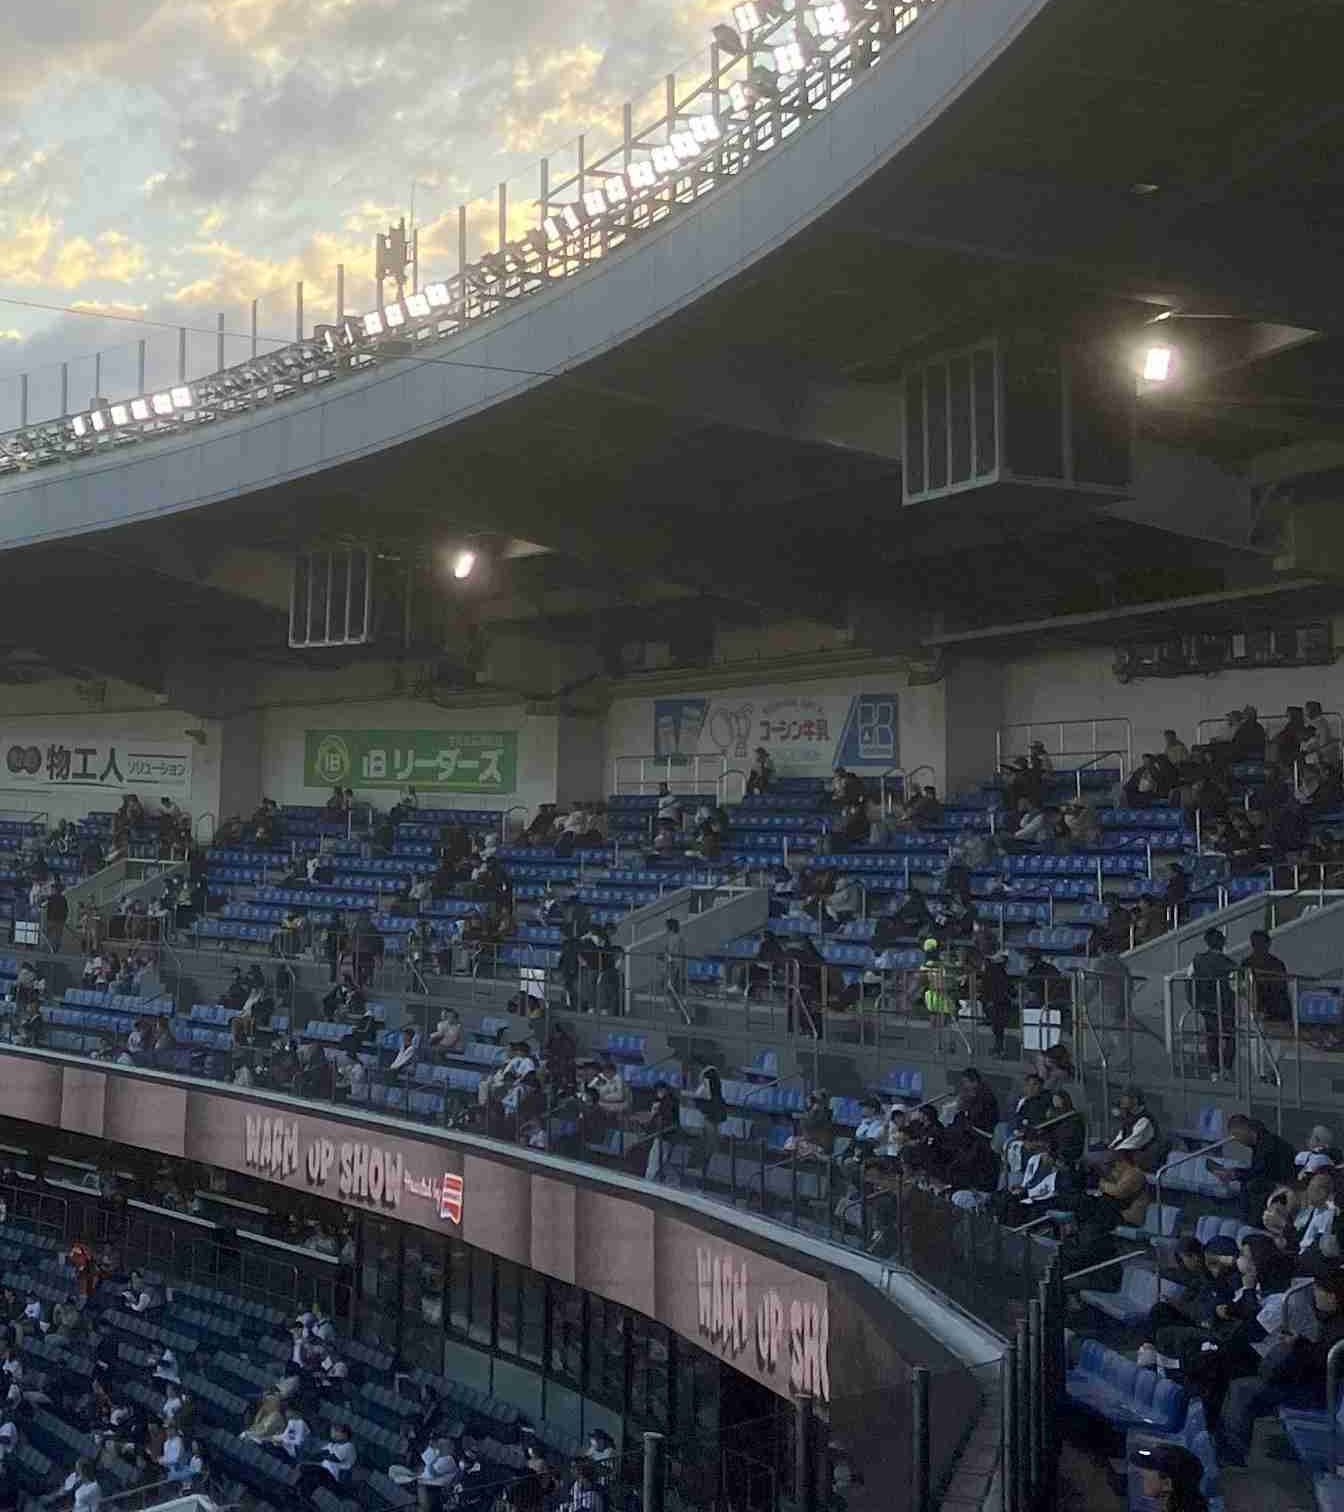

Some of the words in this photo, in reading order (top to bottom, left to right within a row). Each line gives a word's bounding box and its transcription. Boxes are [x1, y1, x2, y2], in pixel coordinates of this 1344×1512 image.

[307, 1136, 335, 1186] UP
[339, 1141, 404, 1209] SHOW
[756, 1288, 786, 1374] UP
